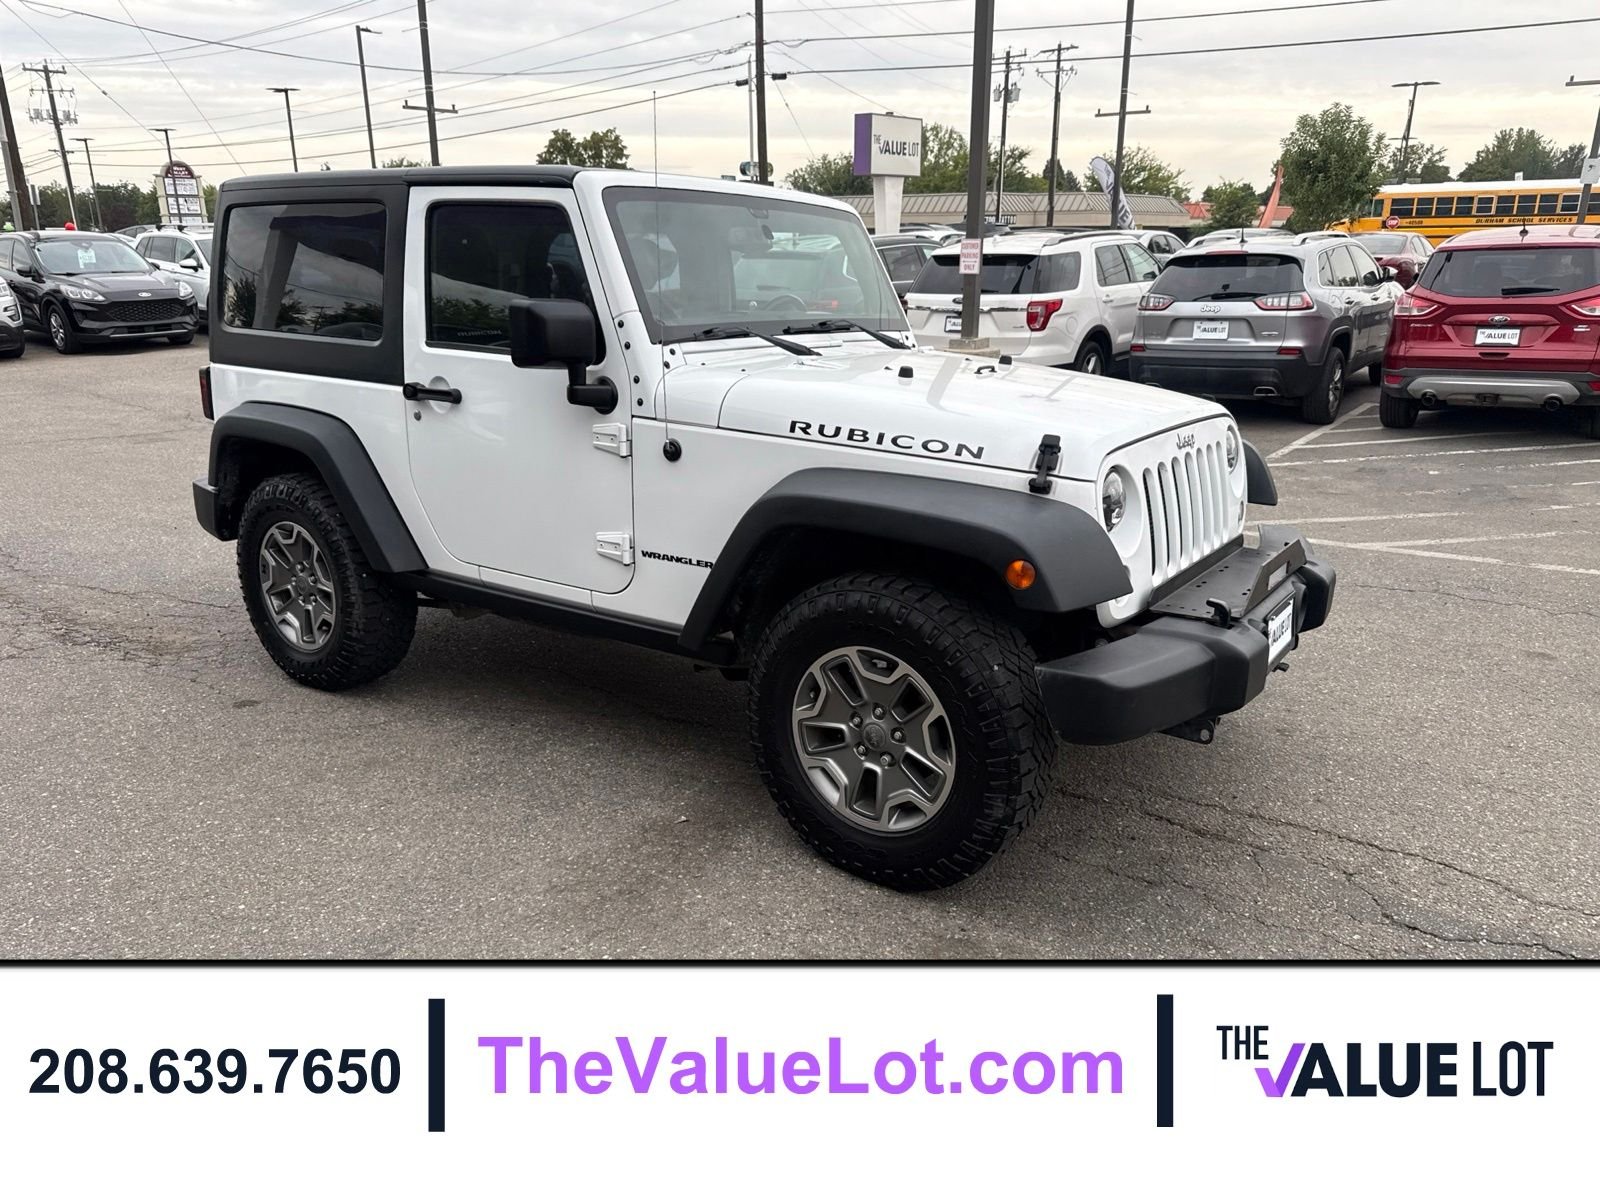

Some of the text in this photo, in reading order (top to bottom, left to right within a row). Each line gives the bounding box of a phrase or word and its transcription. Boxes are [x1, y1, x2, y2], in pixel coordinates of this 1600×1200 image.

[873, 134, 881, 145] THE
[879, 140, 919, 157] VALUE LOT
[1537, 216, 1573, 224] SERVICES
[963, 263, 976, 271] ONLY
[1200, 304, 1221, 314] Jeep
[789, 420, 985, 460] RUBICON
[1176, 433, 1195, 450] Jeep
[641, 550, 714, 570] WRANGLER
